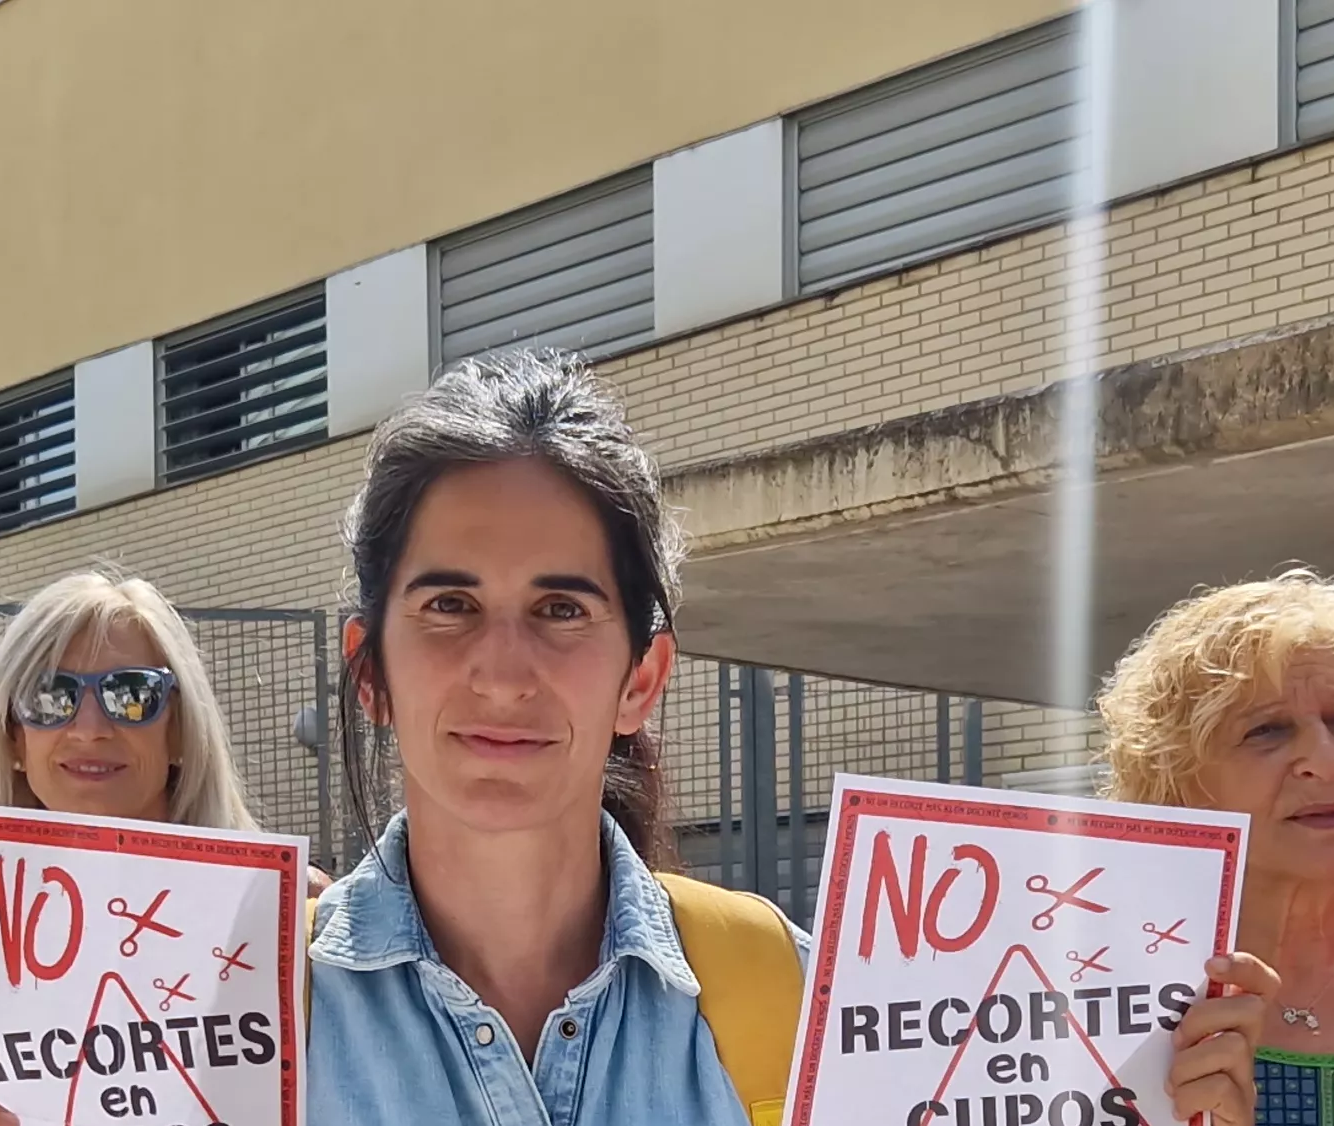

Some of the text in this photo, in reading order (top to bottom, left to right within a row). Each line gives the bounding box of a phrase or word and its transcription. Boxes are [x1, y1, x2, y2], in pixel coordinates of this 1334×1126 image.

[859, 830, 1000, 967] NO
[842, 984, 1197, 1054] RECORTES
[987, 1053, 1048, 1083] en
[101, 1085, 156, 1117] en
